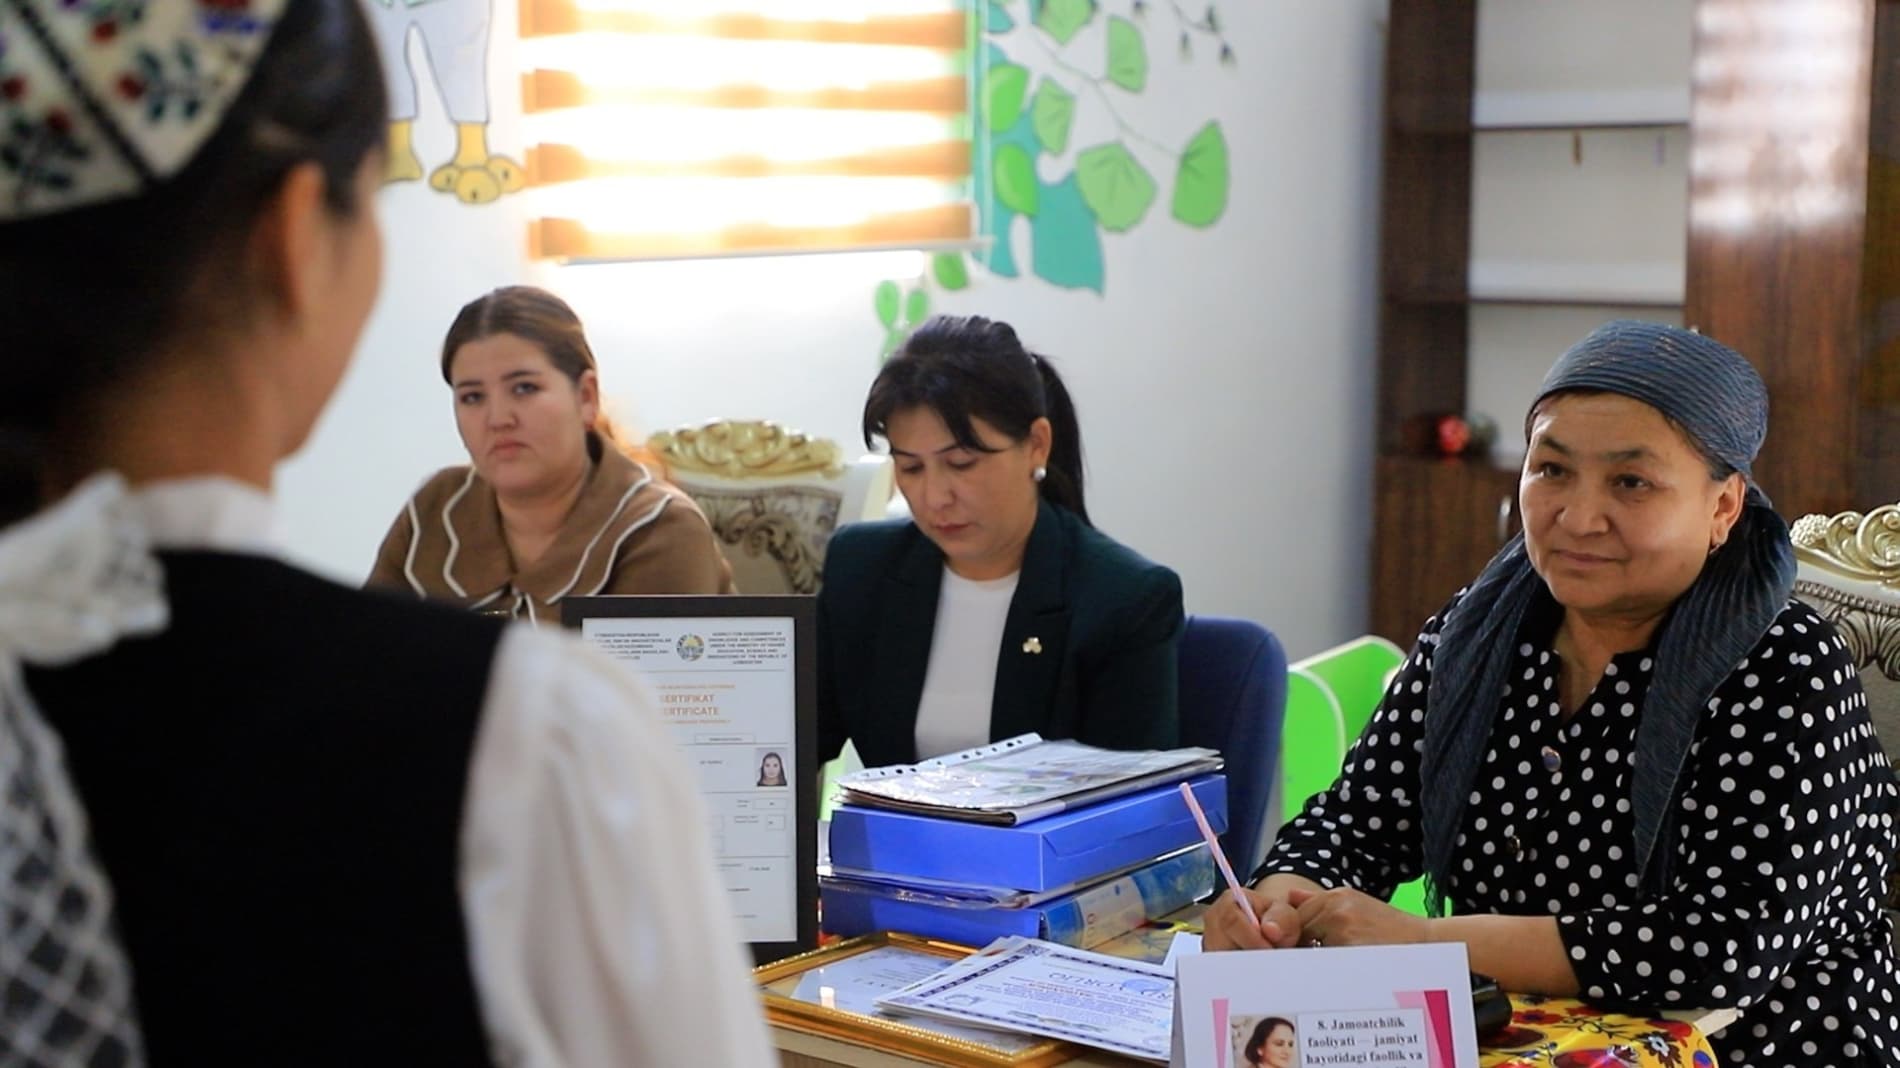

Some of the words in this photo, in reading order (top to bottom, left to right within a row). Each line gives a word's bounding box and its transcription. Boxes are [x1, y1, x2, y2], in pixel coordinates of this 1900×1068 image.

[660, 706, 719, 715] ERTIFICATE
[1331, 1017, 1405, 1030] Jamoatchilik
[1308, 1036, 1356, 1048] faoliyati
[1374, 1034, 1418, 1047] jamiyat
[1306, 1051, 1367, 1066] hayotidagi
[1370, 1050, 1406, 1062] faollik
[1409, 1052, 1423, 1060] va
